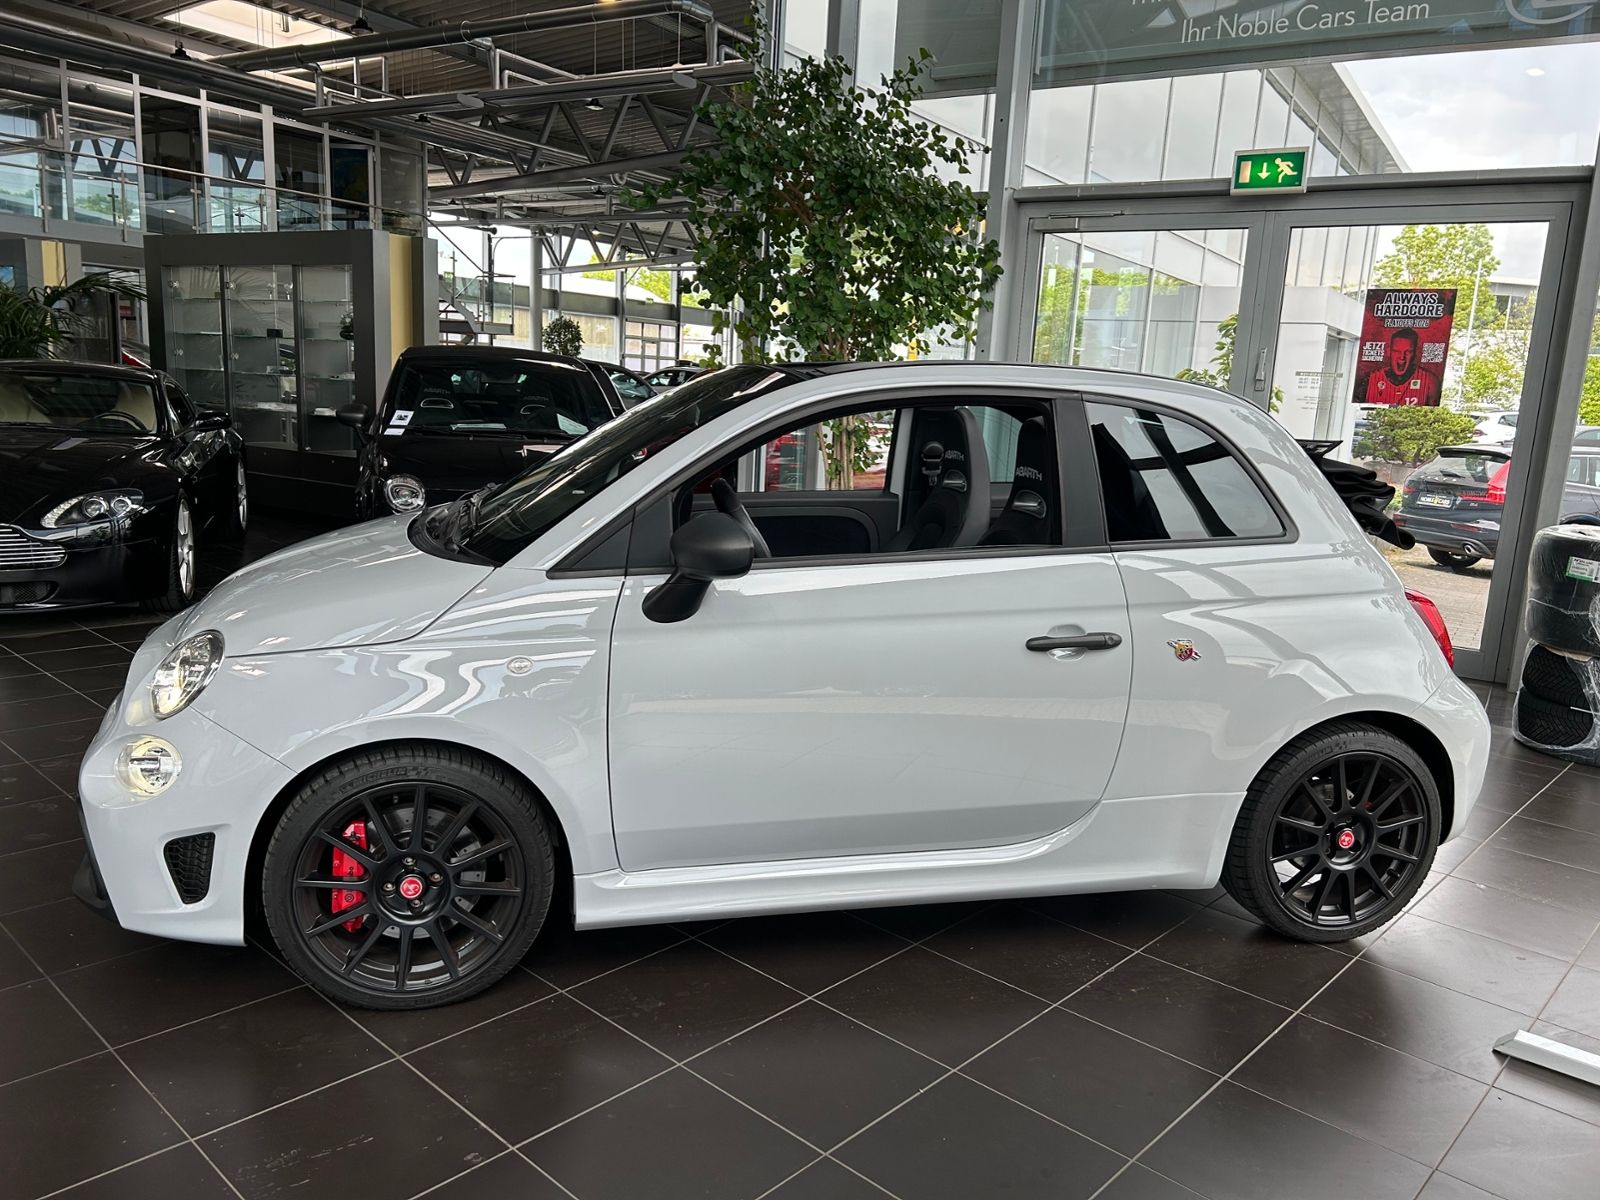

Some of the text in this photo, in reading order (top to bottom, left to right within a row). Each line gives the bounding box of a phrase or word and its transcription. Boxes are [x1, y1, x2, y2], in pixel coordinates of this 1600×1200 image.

[1181, 0, 1430, 43] Ihr Noble Cars Team
[1383, 292, 1438, 305] ALWAYS
[1374, 304, 1444, 317] HARDCORE
[1384, 318, 1413, 327] PLAYOFFS
[1362, 341, 1386, 350] JETZT
[1405, 396, 1418, 406] 12
[944, 449, 964, 461] ABARTH
[1016, 466, 1042, 481] ABARTH
